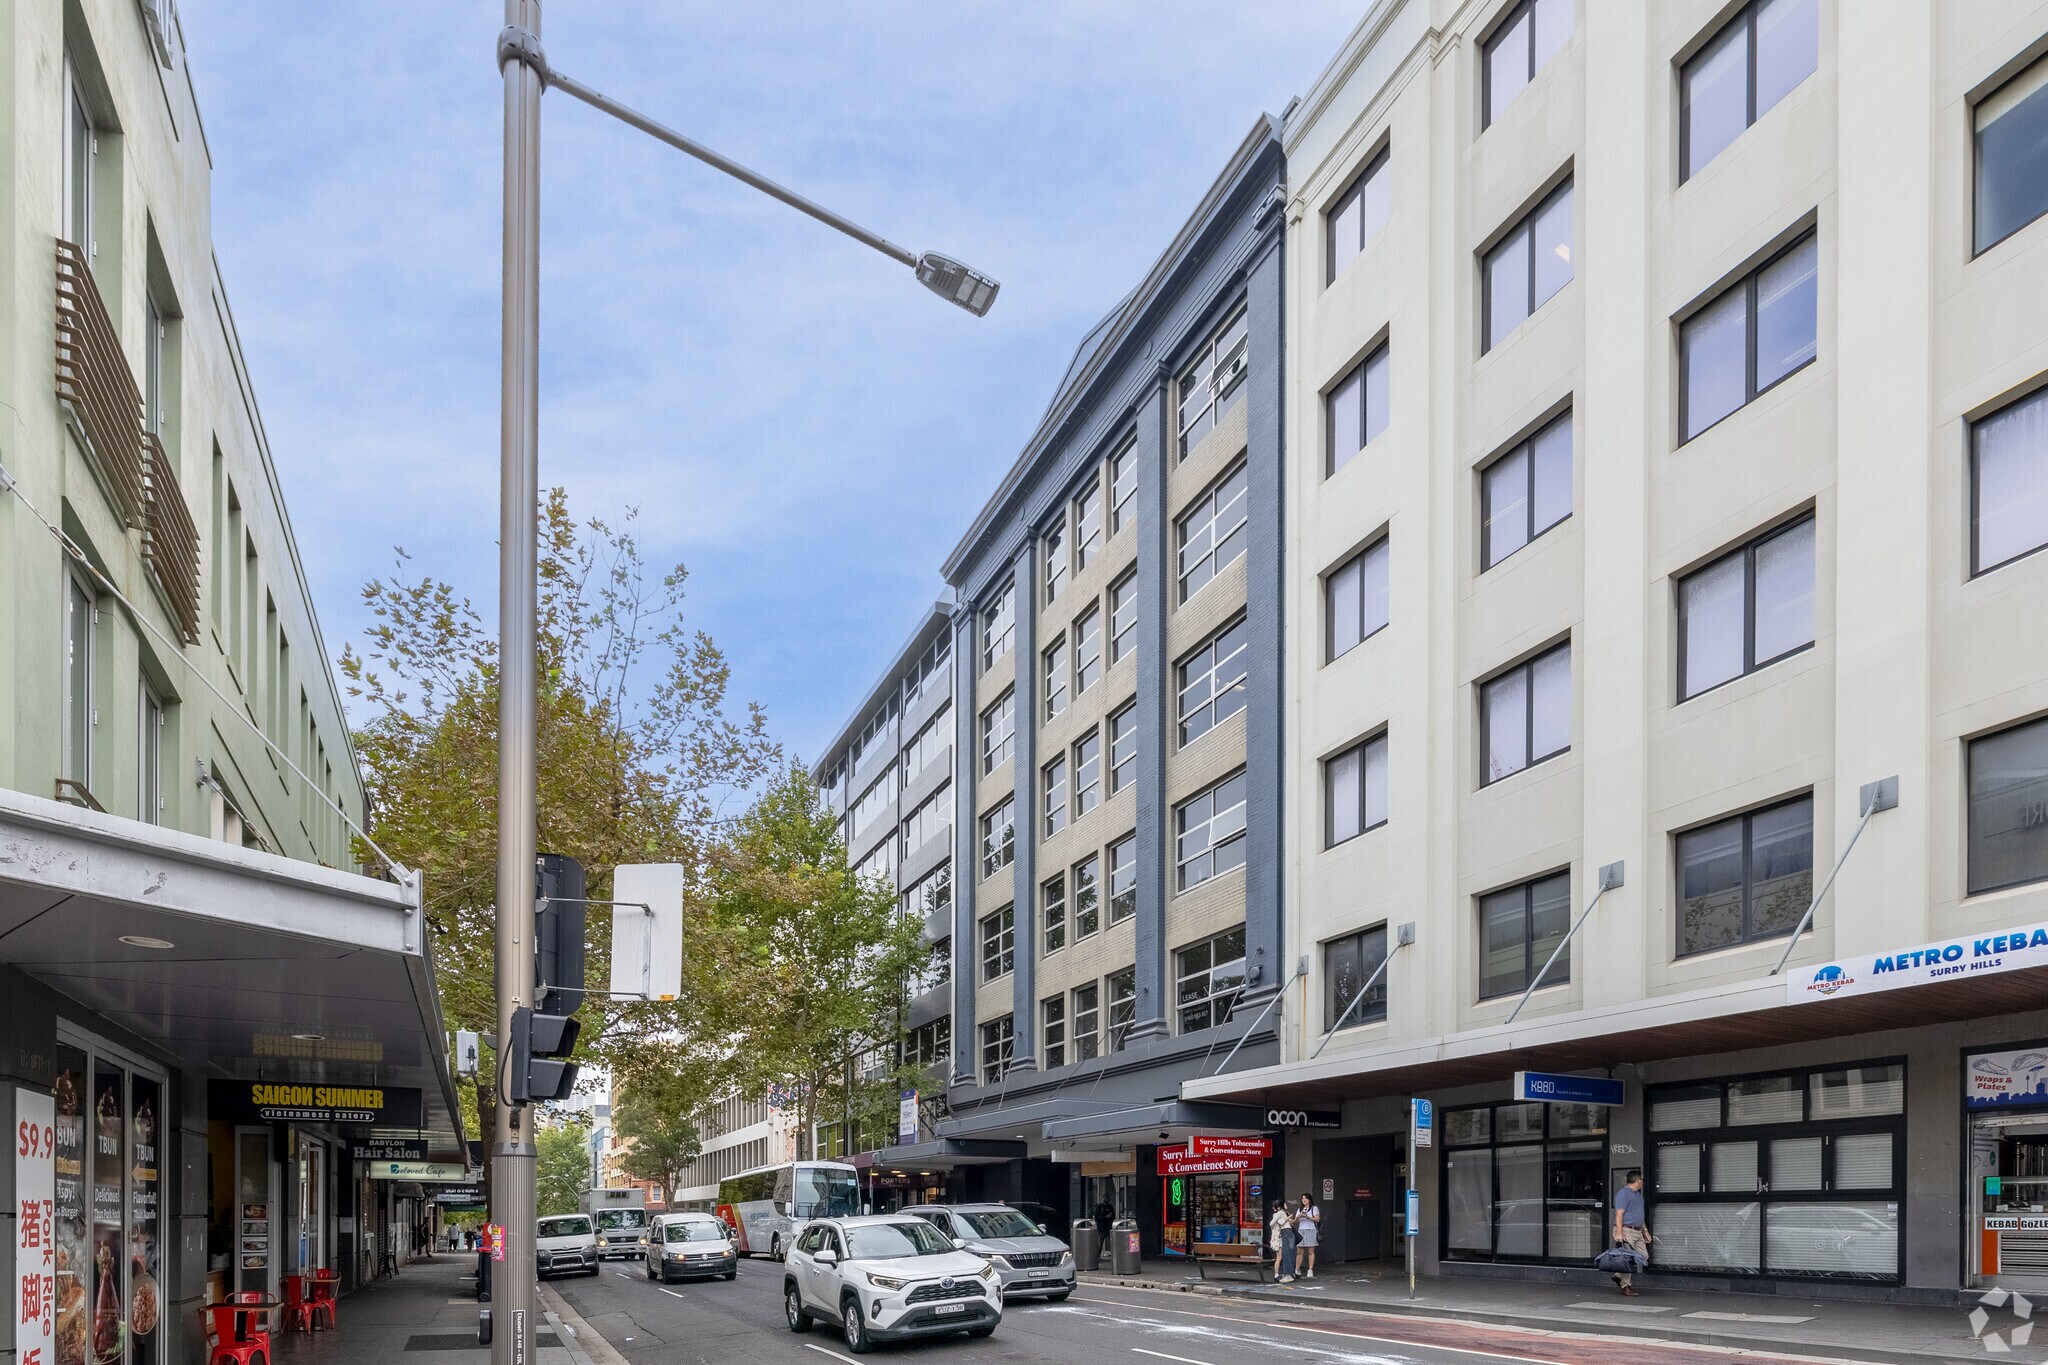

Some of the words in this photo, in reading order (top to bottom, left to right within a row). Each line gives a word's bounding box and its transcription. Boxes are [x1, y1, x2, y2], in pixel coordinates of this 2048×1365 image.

[1873, 945, 1963, 975] METRO
[1930, 964, 1966, 977] SURRY
[1970, 959, 2002, 971] HILLS
[1807, 983, 1830, 991] METRO
[1832, 979, 1855, 987] KEBAB
[1974, 1075, 2003, 1083] Wraps
[1977, 1083, 2007, 1091] Plates
[315, 1087, 384, 1109] SUMMER
[265, 1110, 330, 1119] vietnamese
[1268, 1109, 1308, 1126] acon
[98, 1135, 117, 1155] TBUN
[1199, 1138, 1216, 1147] Surry
[1217, 1138, 1231, 1146] Hills
[136, 1144, 154, 1162] TBUN
[353, 1147, 384, 1159] Hair
[385, 1147, 420, 1159] Salon
[1162, 1150, 1184, 1162] Surry
[1210, 1147, 1244, 1155] Convenience
[390, 1163, 423, 1175] Beloved
[426, 1164, 446, 1178] Cafe
[1168, 1163, 1174, 1173] &
[1175, 1161, 1223, 1172] Convenience
[1225, 1158, 1249, 1169] Store
[94, 1187, 120, 1203] Delicious!
[1986, 1220, 2018, 1228] KEBAB
[43, 1199, 54, 1267] Pork
[43, 1275, 54, 1338] Rice
